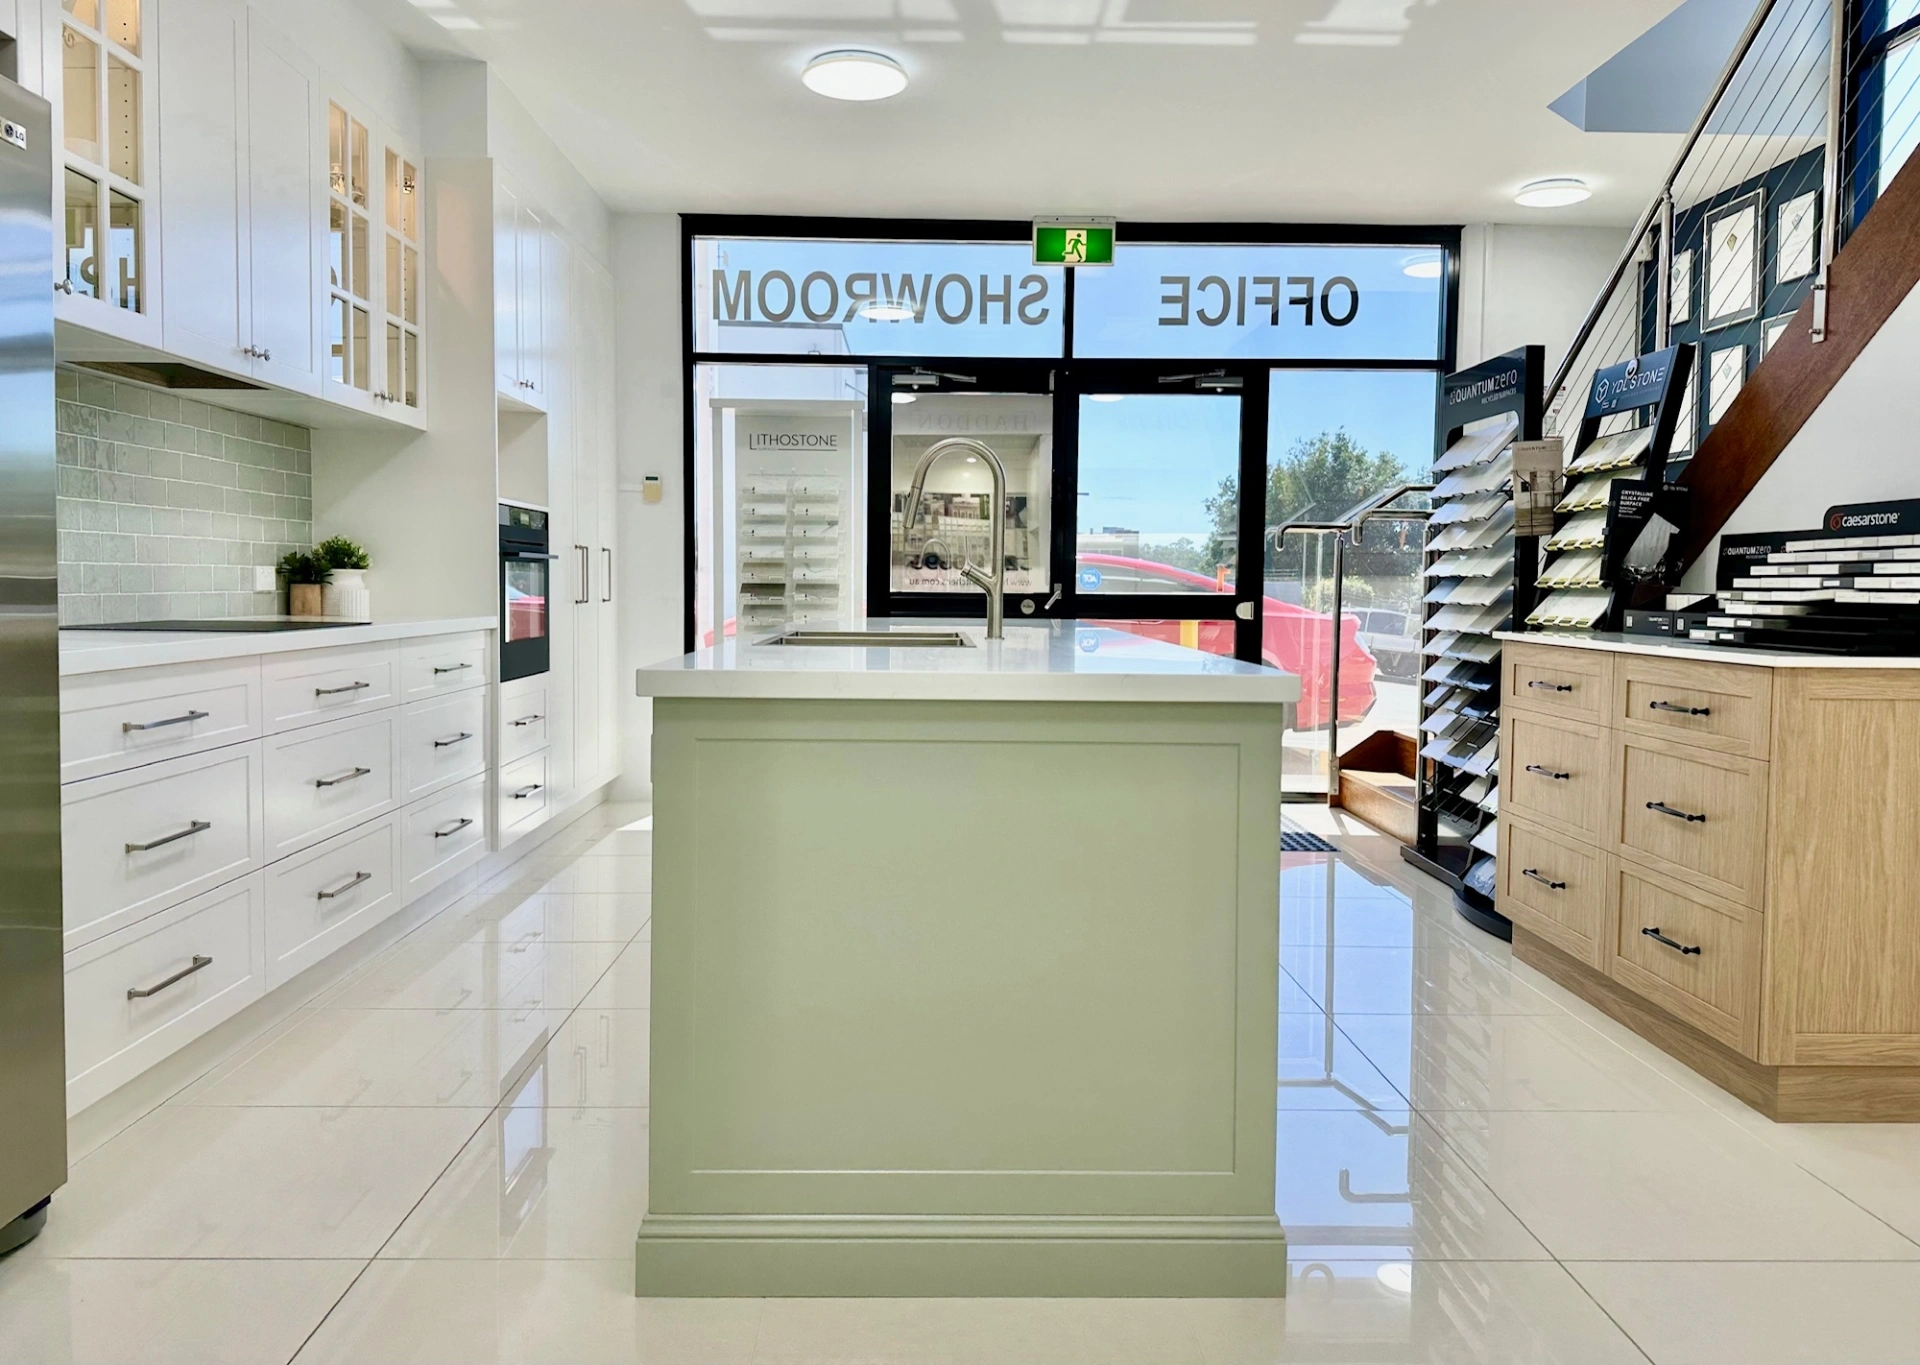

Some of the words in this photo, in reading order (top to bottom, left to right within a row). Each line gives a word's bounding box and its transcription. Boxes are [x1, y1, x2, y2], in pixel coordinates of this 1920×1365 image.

[1611, 377, 1628, 395] YDL
[1629, 366, 1666, 390] STONE
[749, 433, 838, 450] LITHOSTONE
[1842, 511, 1899, 528] caesarstone
